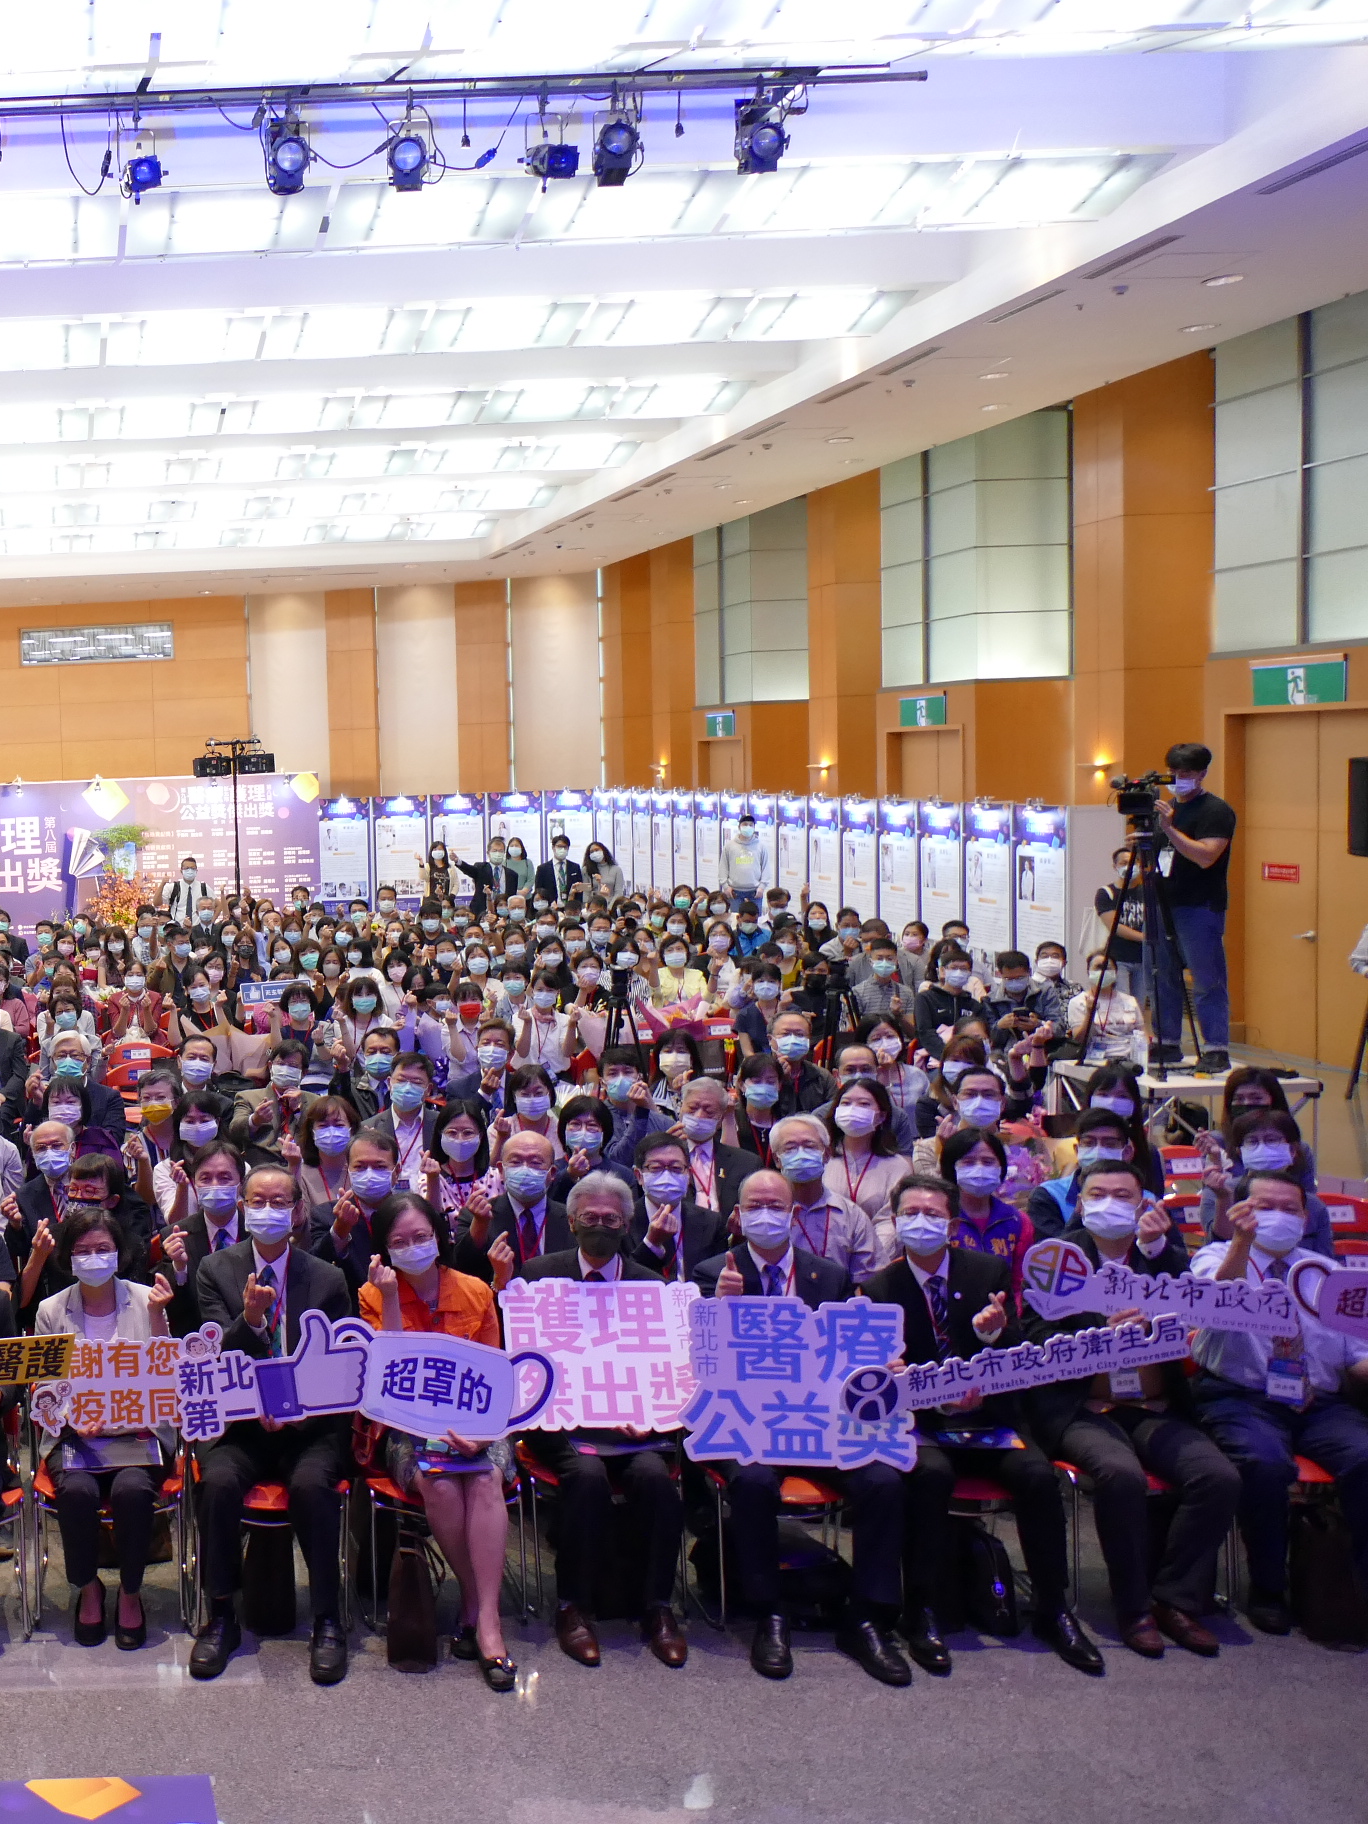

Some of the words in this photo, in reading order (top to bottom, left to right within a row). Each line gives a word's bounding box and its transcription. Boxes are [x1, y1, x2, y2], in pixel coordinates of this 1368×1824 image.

[44, 816, 57, 854] 第八屆
[505, 1283, 671, 1355] 護理
[1103, 1268, 1292, 1321] 新北市政府
[694, 1304, 719, 1377] 新北市
[727, 1303, 898, 1383] 醫療
[908, 1318, 1185, 1393] 新北市政府衛生局
[179, 1355, 254, 1396] 新北
[381, 1356, 492, 1414] 超罩的
[911, 1388, 969, 1407] Departmen
[991, 1377, 1029, 1391] Health,
[1033, 1372, 1054, 1383] New
[1059, 1364, 1093, 1377] Taipei
[1096, 1360, 1118, 1370] City
[1123, 1348, 1186, 1365] Government
[183, 1399, 256, 1437] 第一
